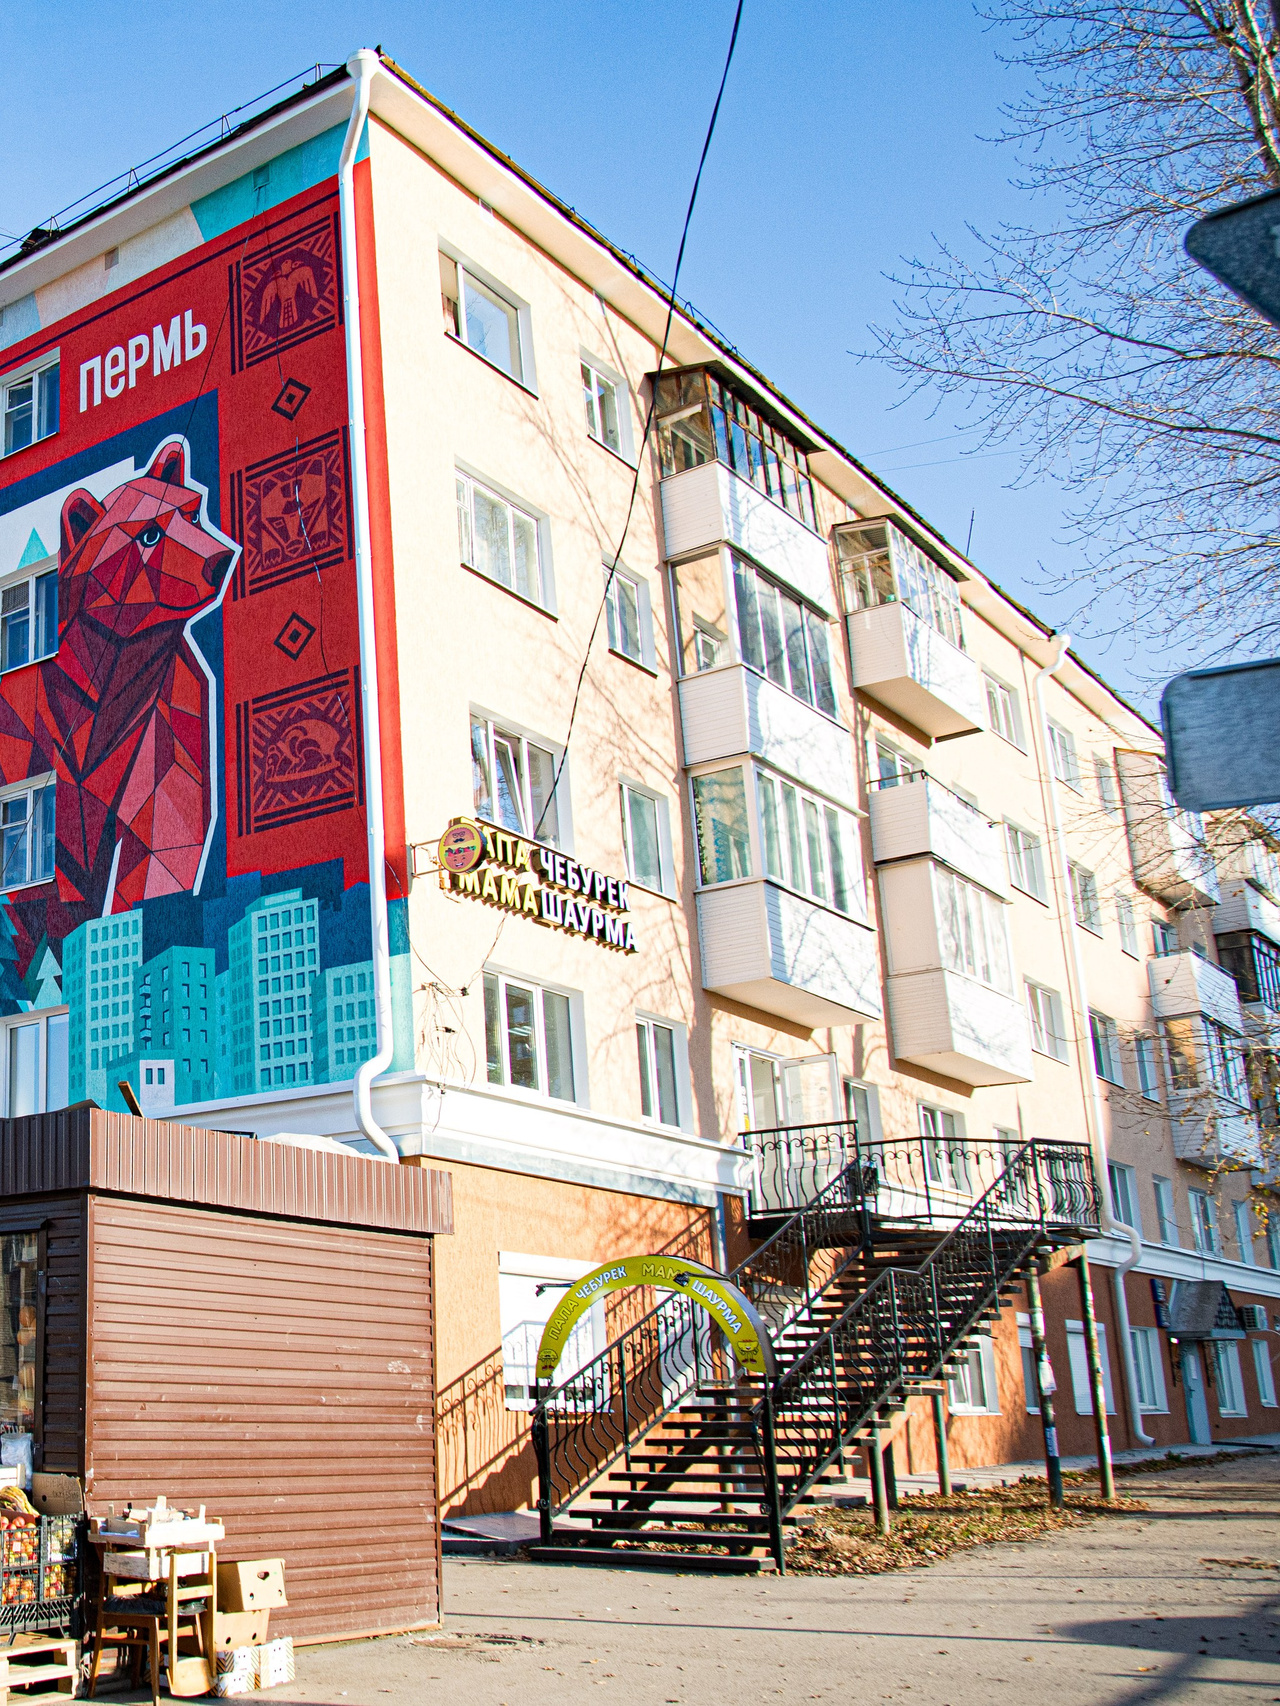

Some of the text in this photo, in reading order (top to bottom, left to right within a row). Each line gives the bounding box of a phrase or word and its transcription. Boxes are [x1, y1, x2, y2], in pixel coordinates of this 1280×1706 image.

[461, 817, 631, 912] АПА ЧЕБУРЕК
[459, 868, 639, 951] МАМА ШАУРМА
[548, 1263, 743, 1340] ПАПА ЧЕБУРЕК МАМ ШАУРМА
